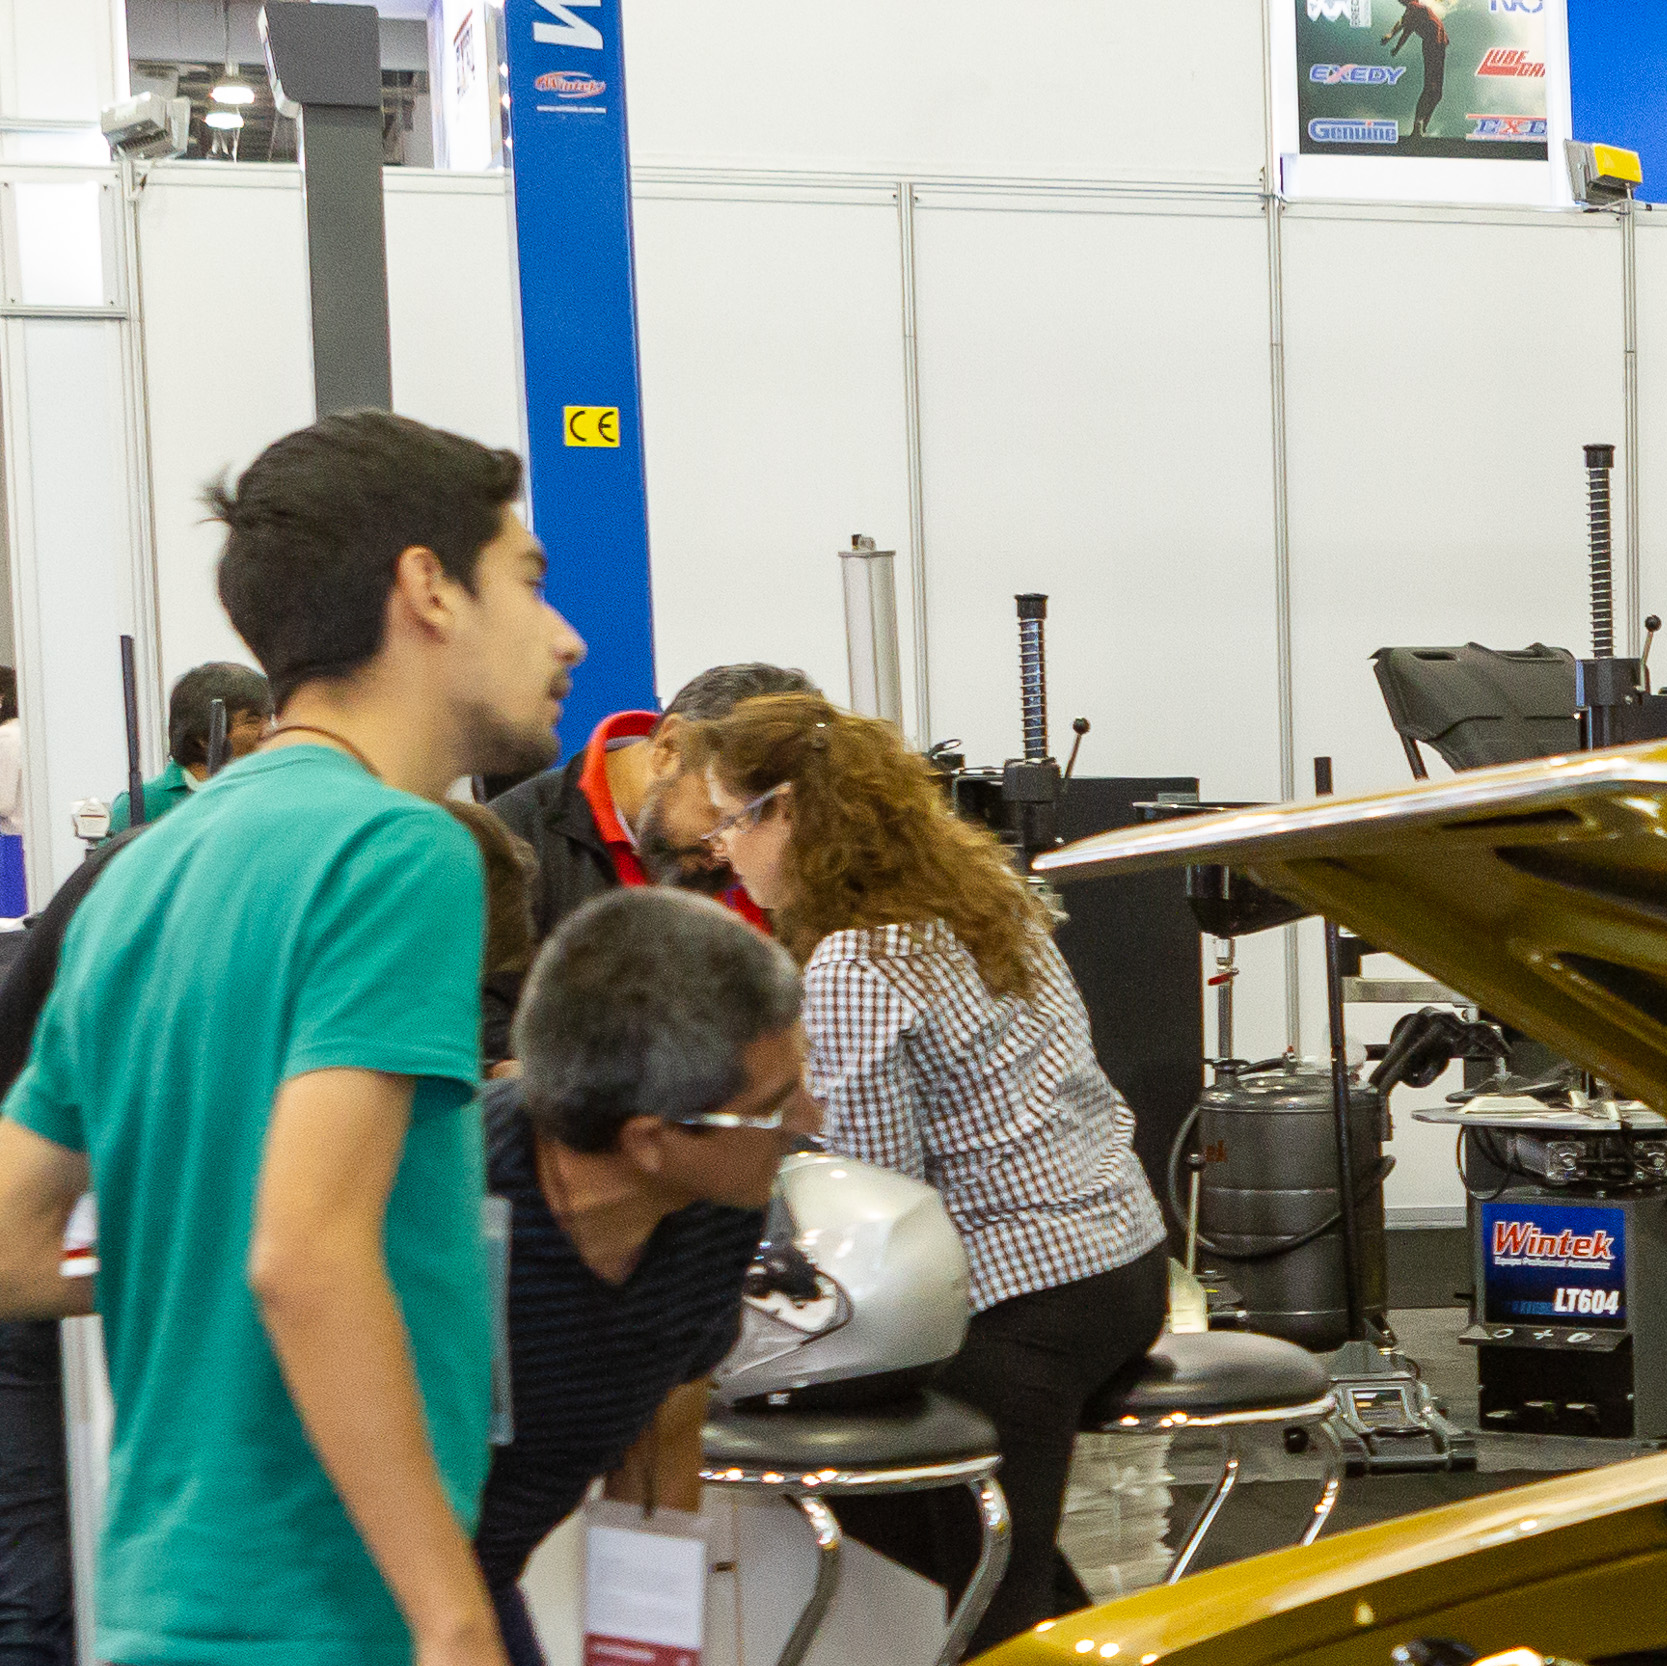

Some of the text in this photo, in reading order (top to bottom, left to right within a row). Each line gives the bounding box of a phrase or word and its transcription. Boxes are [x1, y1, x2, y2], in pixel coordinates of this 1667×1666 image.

[1310, 65, 1404, 84] EXEDY
[1310, 119, 1397, 142] Genuine
[570, 410, 615, 442] CE
[1493, 1221, 1615, 1260] Wintek
[1554, 1287, 1620, 1316] LT604
